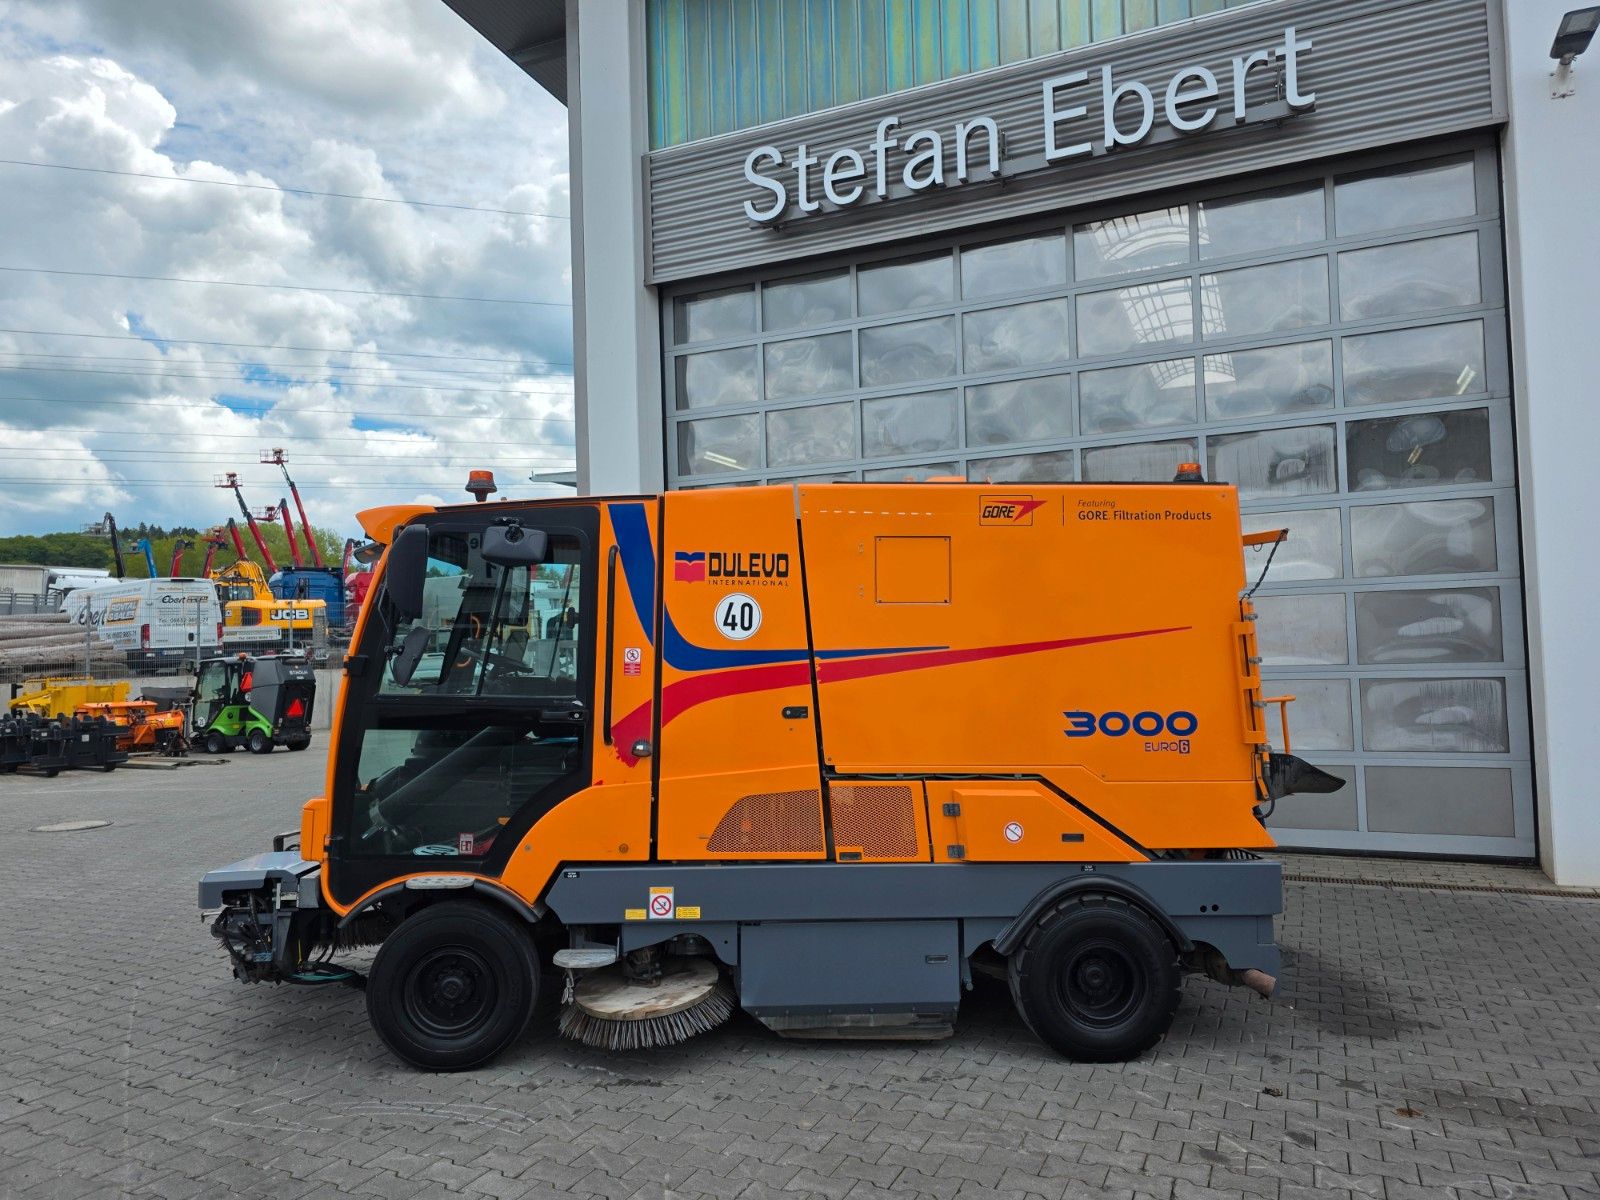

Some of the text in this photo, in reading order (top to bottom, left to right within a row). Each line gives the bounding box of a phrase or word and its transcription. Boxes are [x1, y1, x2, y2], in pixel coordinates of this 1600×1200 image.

[743, 26, 1317, 223] Stefan Ebert
[982, 506, 1015, 518] GORE
[1077, 499, 1116, 508] Featuring
[1113, 510, 1161, 521] Filtration
[1164, 510, 1212, 521] Products
[708, 552, 789, 577] DULEVO
[271, 609, 309, 620] JCB
[723, 602, 754, 631] 40
[1063, 711, 1198, 737] 3000
